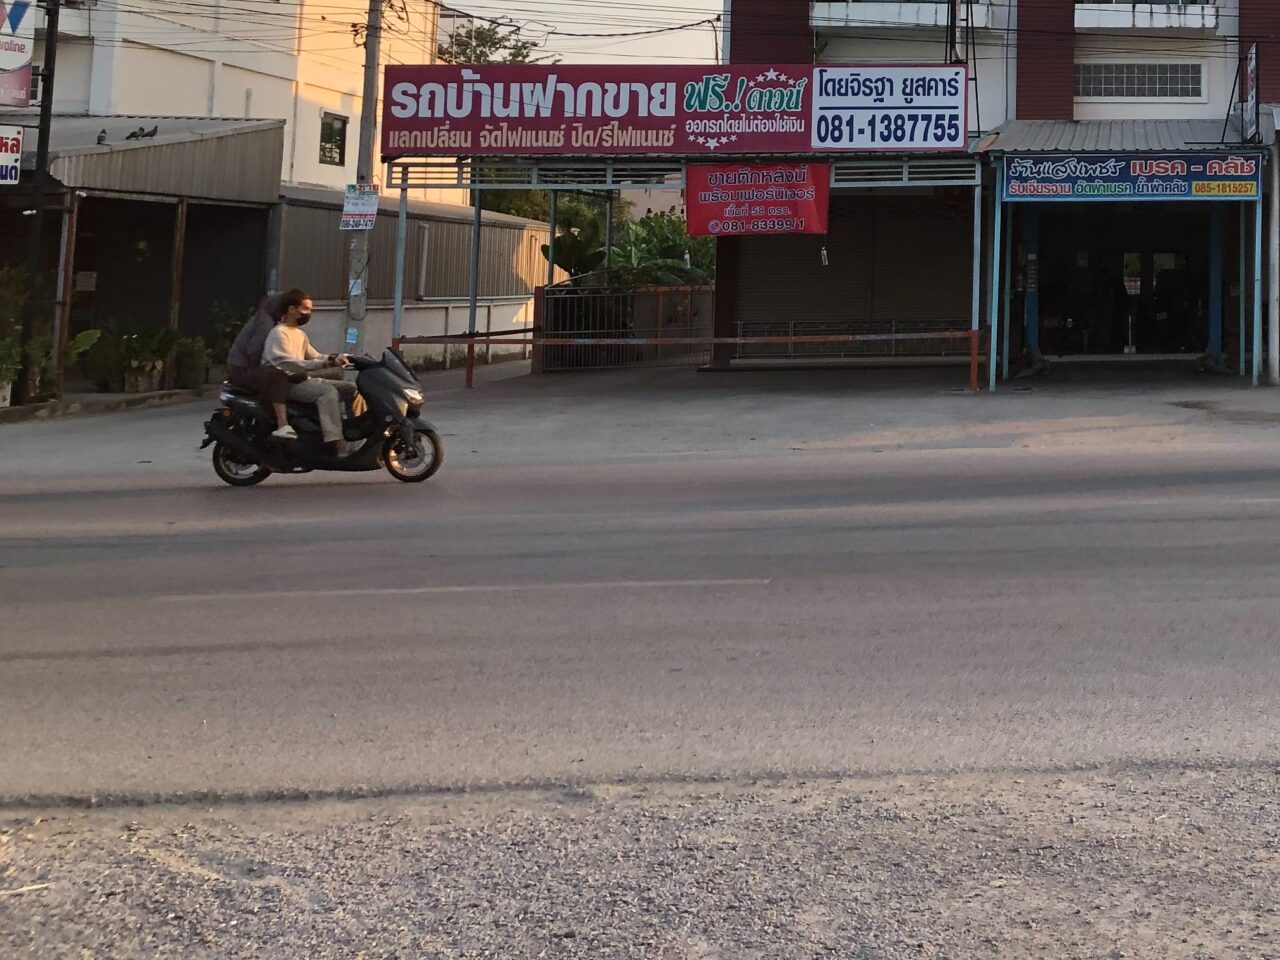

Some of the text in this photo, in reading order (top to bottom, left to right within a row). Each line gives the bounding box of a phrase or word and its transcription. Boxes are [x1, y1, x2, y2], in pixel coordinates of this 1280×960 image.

[391, 68, 677, 118] รถบ้านฝากขาย
[818, 69, 960, 104] โดยจิรฐา ยูสคาร์
[389, 120, 472, 148] แลกเปลี่ยน
[480, 122, 566, 148] จัดไฟแนนซ์
[686, 113, 805, 132] ออกรถโดยไม่ต้องใช้เงิน
[816, 113, 960, 143] 081-1387755
[708, 163, 808, 186] ขายตึกหลังนี้
[1009, 158, 1126, 180] ร้านแสงเพชร
[1131, 160, 1187, 176] เบรค
[1207, 156, 1255, 176] คลัช
[1194, 182, 1254, 194] 085-1815257
